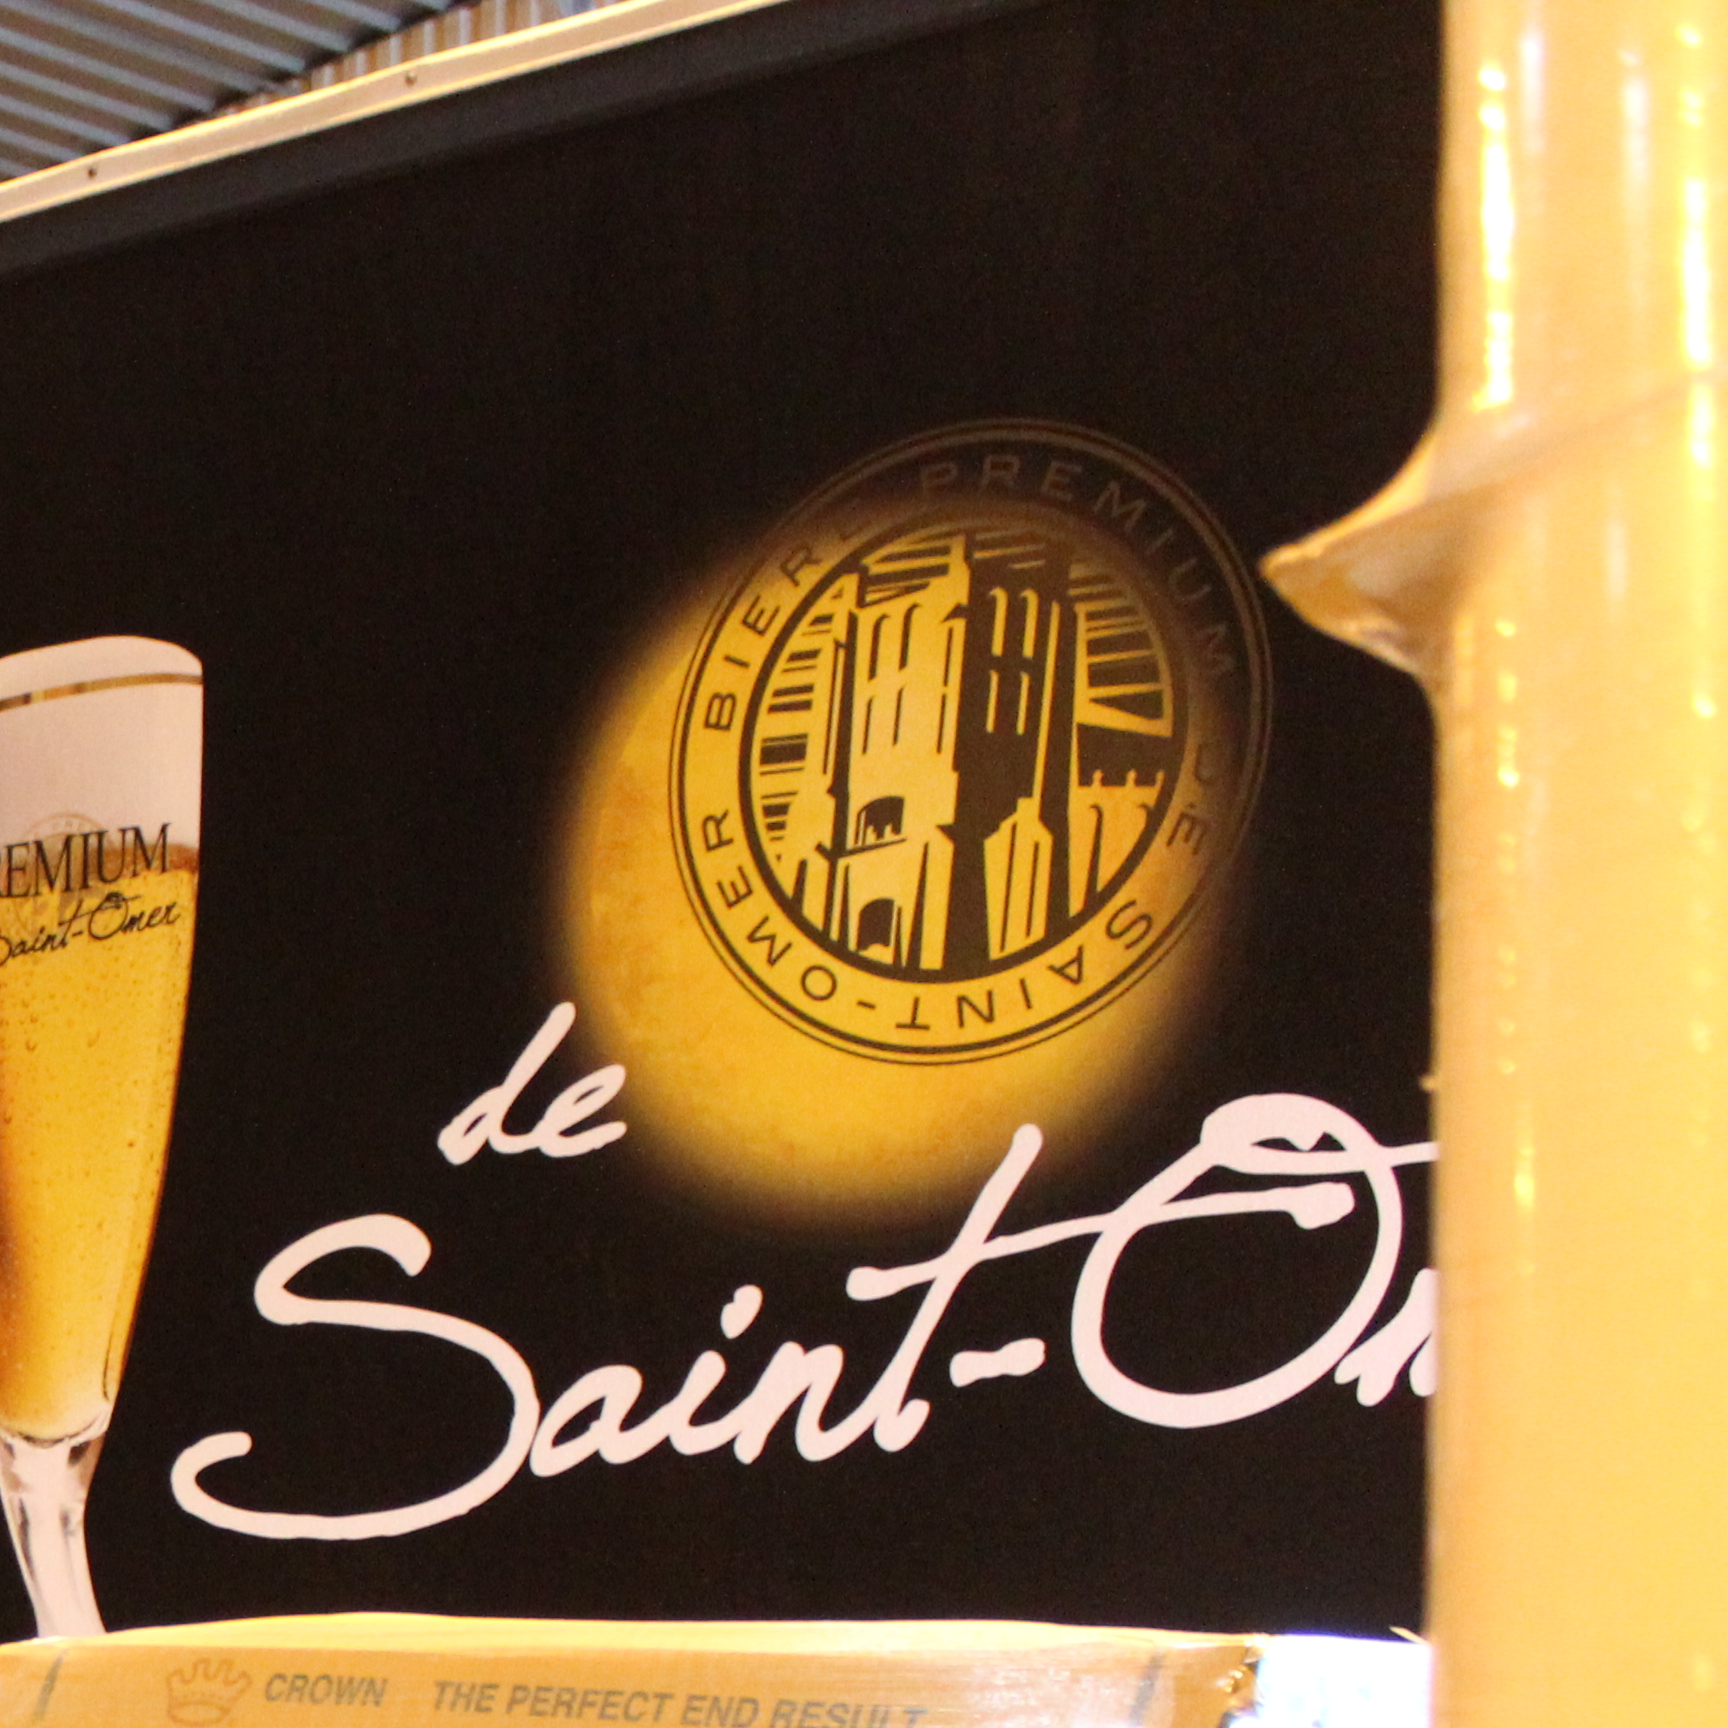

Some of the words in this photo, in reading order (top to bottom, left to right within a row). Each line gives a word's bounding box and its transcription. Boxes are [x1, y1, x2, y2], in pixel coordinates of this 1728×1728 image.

[918, 452, 1238, 680] PREMIUM
[699, 808, 1155, 1032] SAINT-OMER
[437, 1000, 628, 1167] de
[264, 1673, 389, 1707] CROWN
[433, 1680, 500, 1714] THE
[505, 1684, 674, 1724] PERFECT
